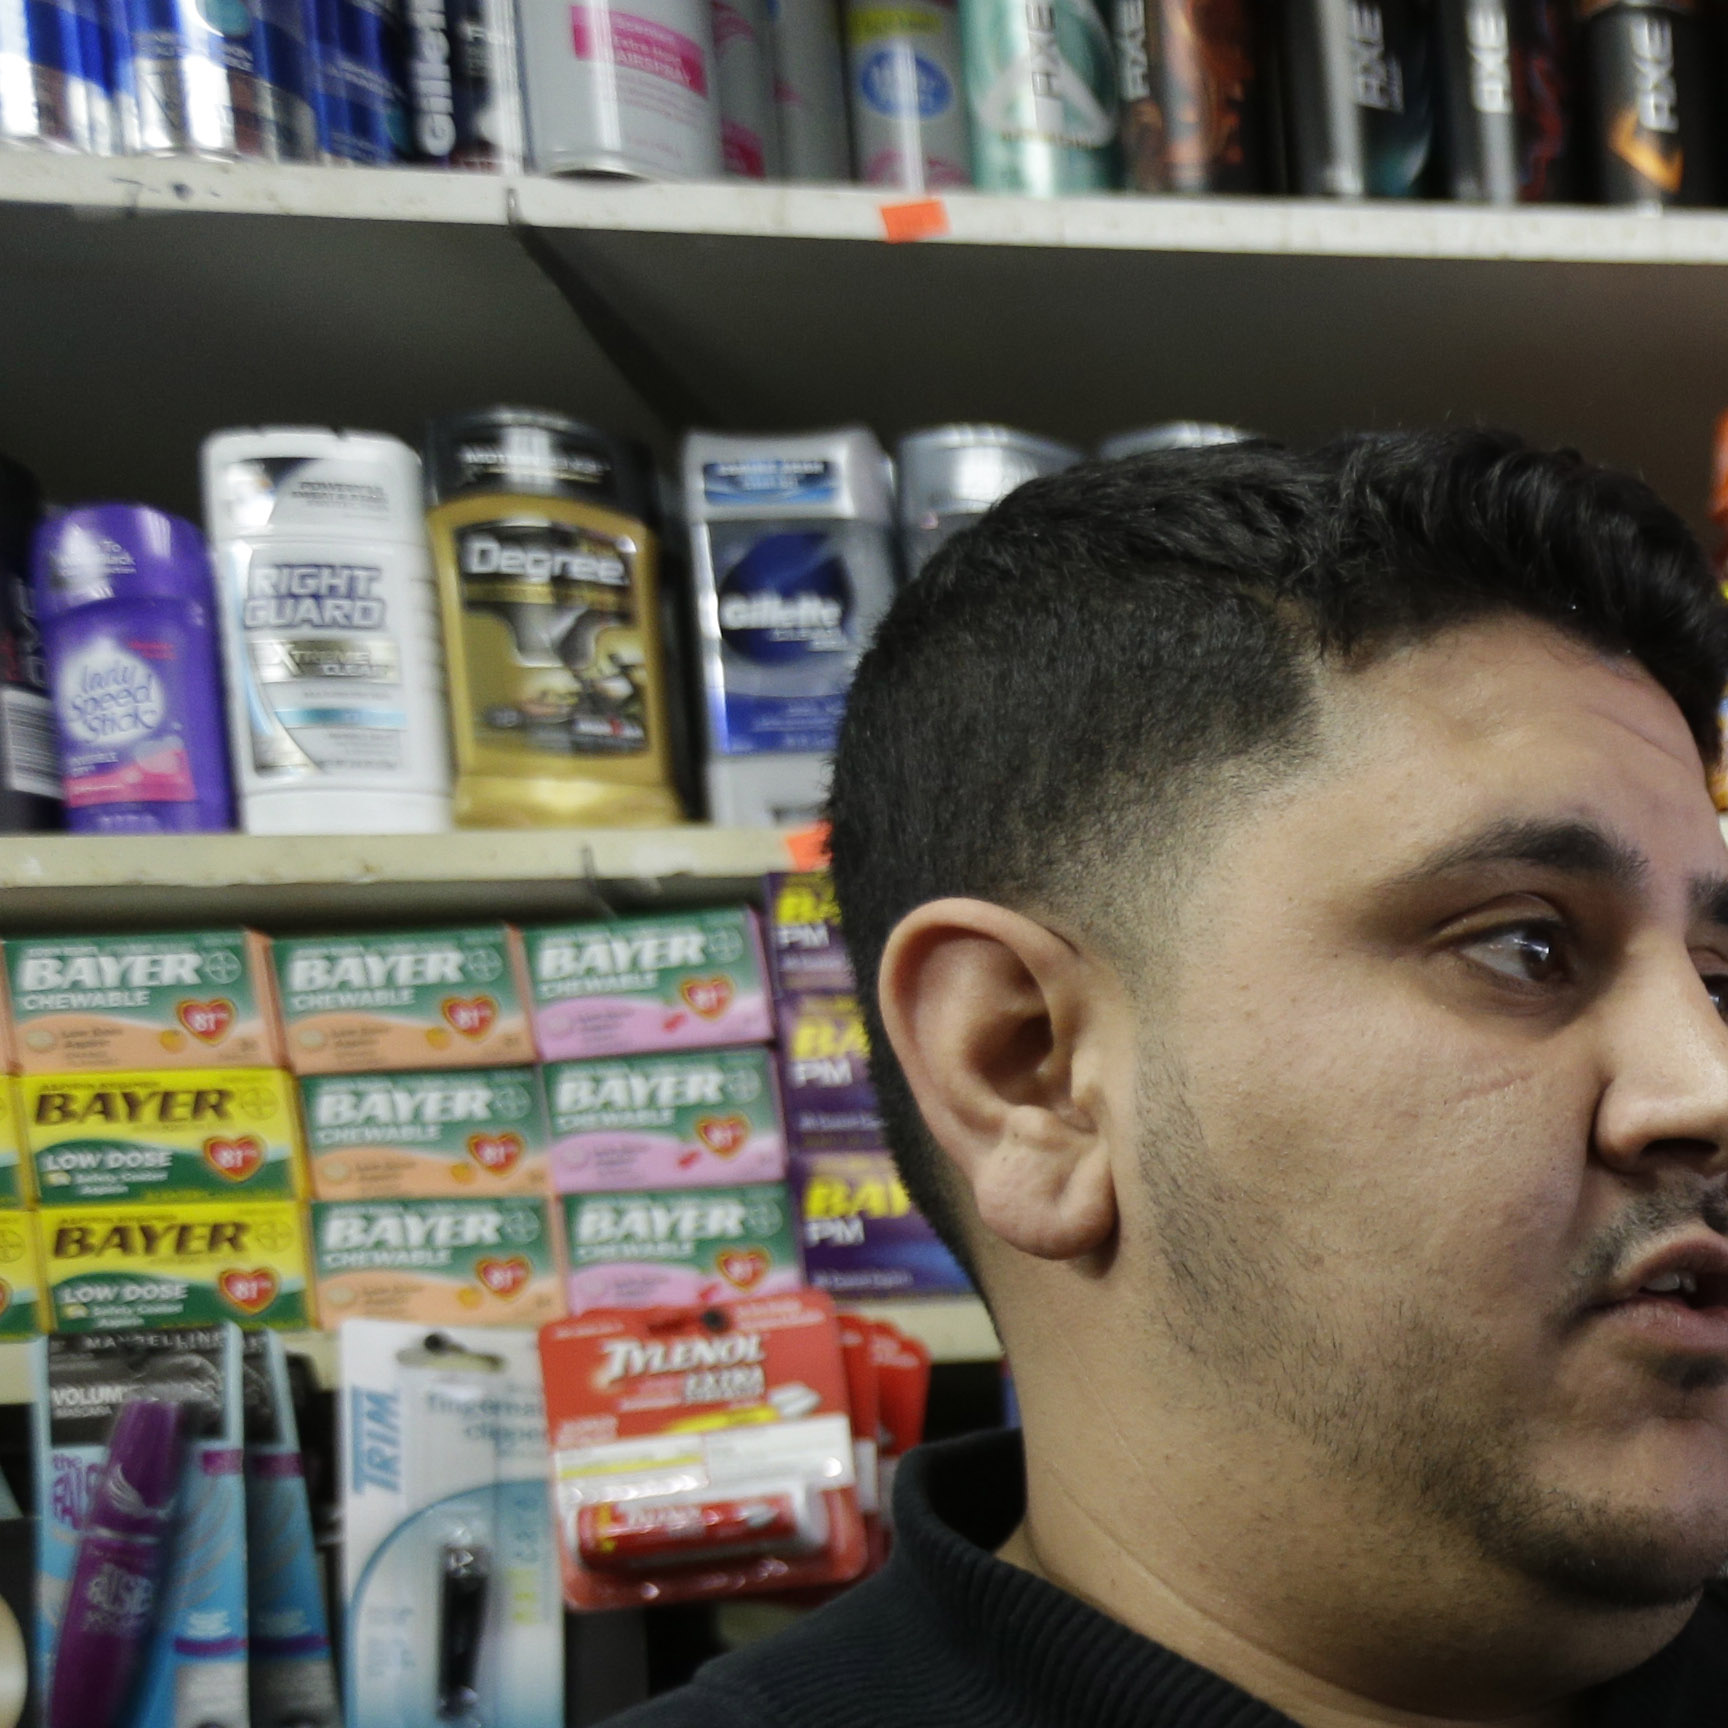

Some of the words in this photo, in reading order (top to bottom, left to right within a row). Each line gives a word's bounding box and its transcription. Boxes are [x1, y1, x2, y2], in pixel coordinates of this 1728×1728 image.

[1465, 8, 1513, 114] AXE
[1630, 14, 1680, 134] AXE
[462, 534, 632, 587] Degree
[252, 563, 382, 600] RIGHT
[243, 595, 388, 630] GUARD
[720, 590, 844, 632] Gillette
[20, 951, 204, 993] BAYER
[289, 949, 467, 993] BAYER
[539, 933, 708, 981] BAYER
[22, 988, 152, 1012] CHEWABLE
[35, 1088, 235, 1126] BAYER
[316, 1089, 494, 1128] BAYER
[556, 1071, 725, 1115] BAYER
[43, 1152, 102, 1172] LOW
[106, 1149, 173, 1170] DOSE
[53, 1221, 251, 1259] BAYER
[323, 1213, 502, 1251] BAYER
[576, 1204, 746, 1245] BAYER
[61, 1286, 119, 1305] LOW
[122, 1283, 189, 1302] DOSE
[596, 1332, 768, 1390] TYLENOL
[352, 1385, 404, 1496] TRIM
